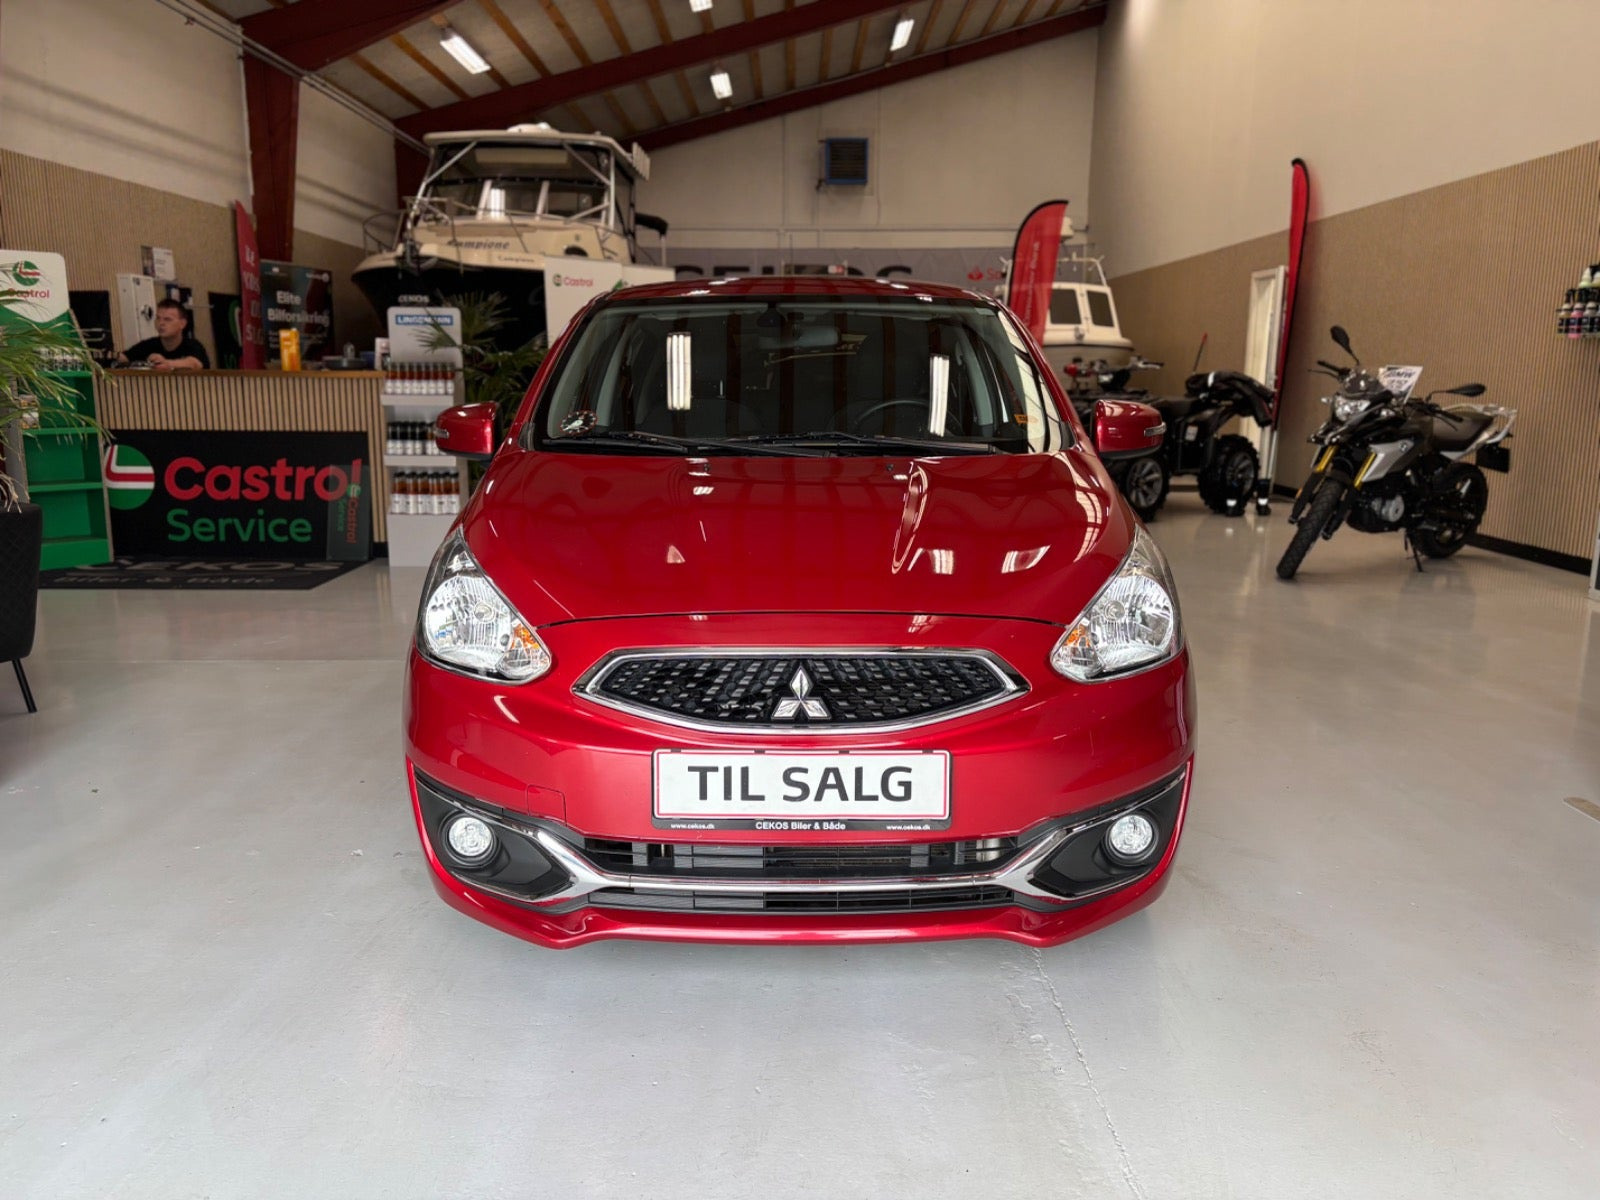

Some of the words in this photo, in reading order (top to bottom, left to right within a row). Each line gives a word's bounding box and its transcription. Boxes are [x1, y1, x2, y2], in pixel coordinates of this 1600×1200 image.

[564, 277, 594, 287] Castrol
[276, 290, 301, 305] Elite
[164, 456, 362, 501] Castrol
[166, 508, 312, 542] Service
[687, 765, 766, 801] TIL
[782, 765, 913, 802] SALG
[755, 821, 789, 830] CEKOS
[790, 821, 811, 830] Biler
[813, 822, 821, 830] &
[822, 821, 846, 830] Både
[886, 823, 931, 831] www.cekos.dk
